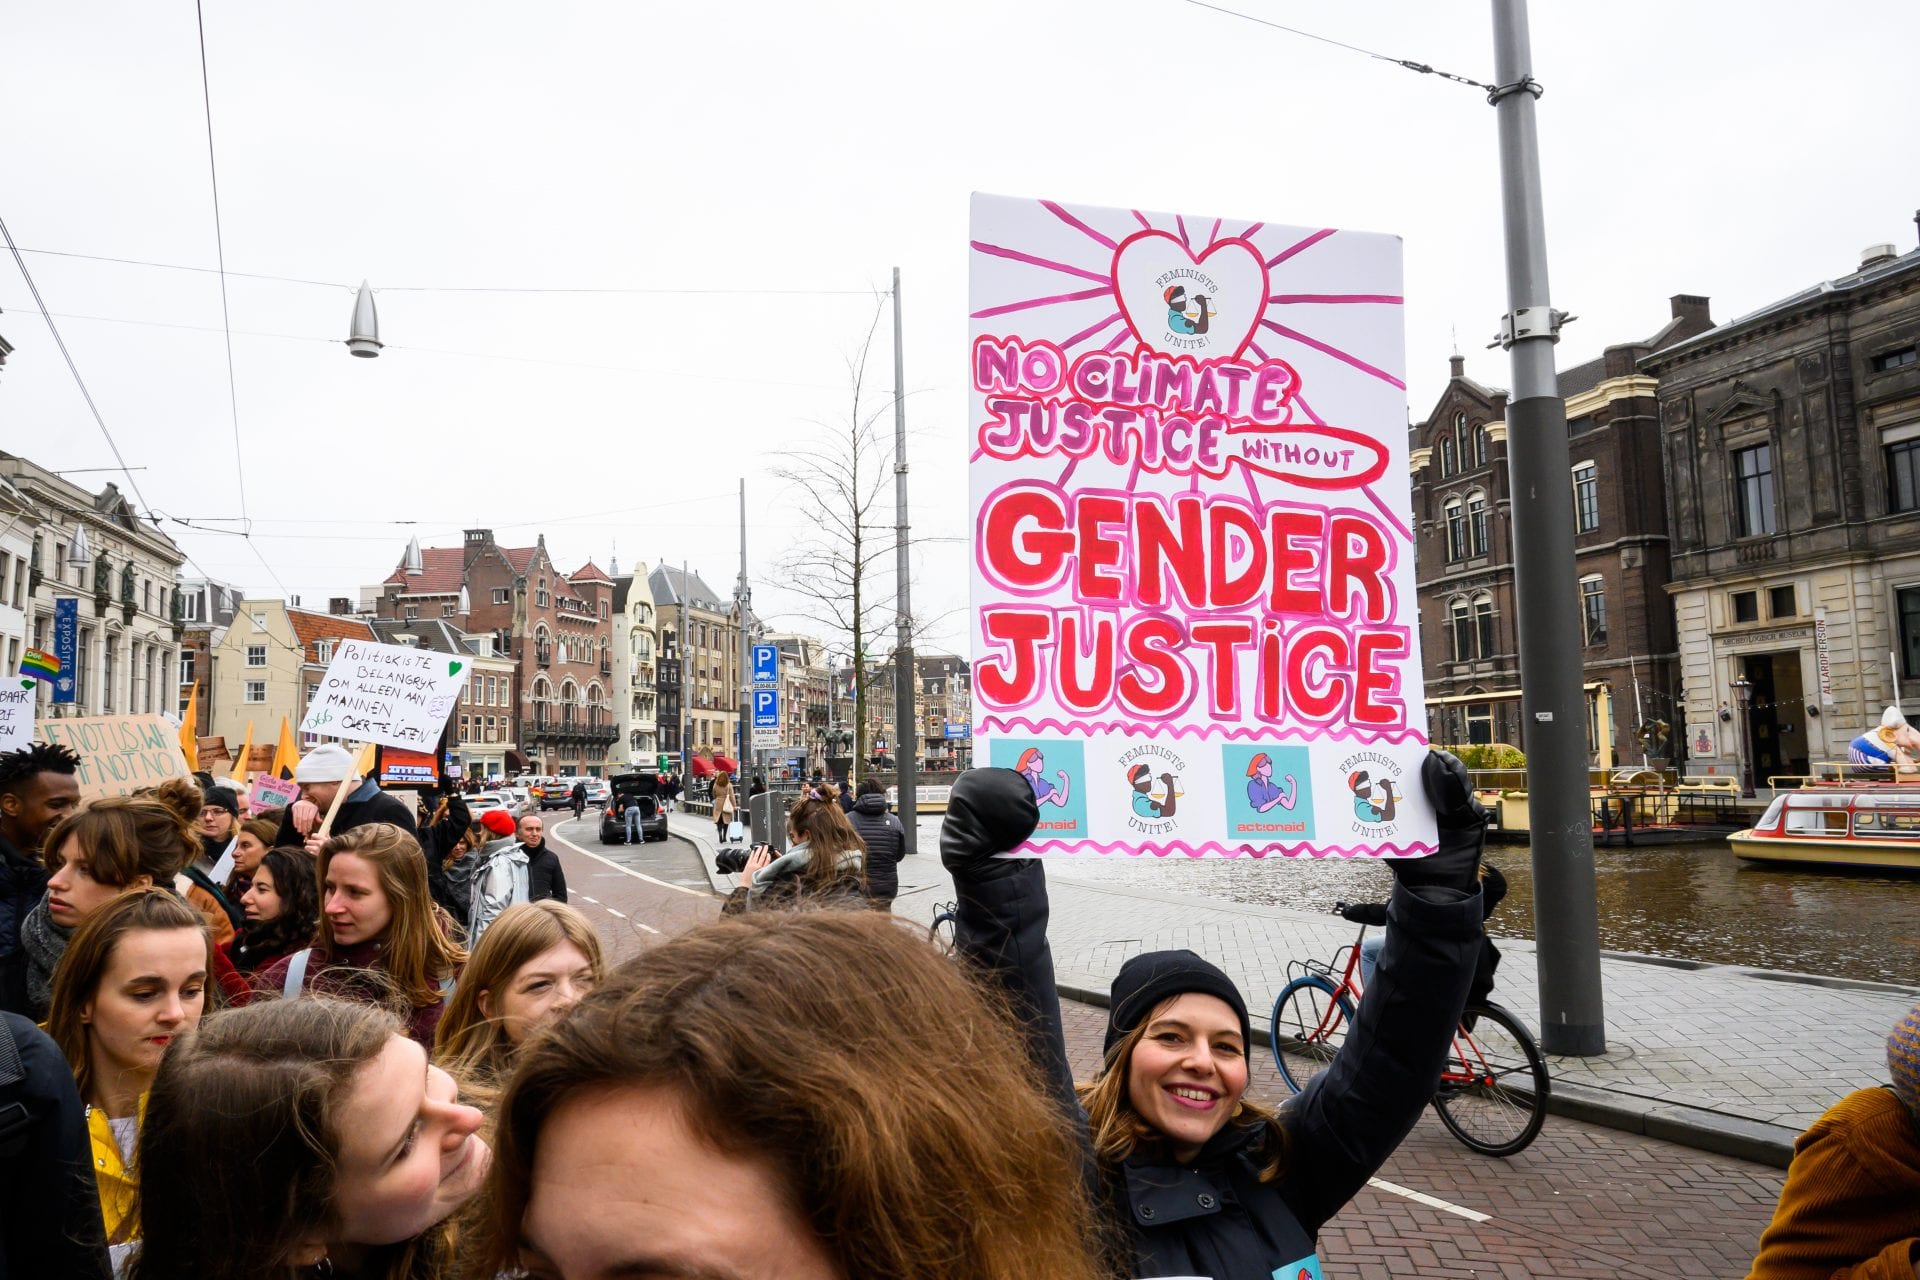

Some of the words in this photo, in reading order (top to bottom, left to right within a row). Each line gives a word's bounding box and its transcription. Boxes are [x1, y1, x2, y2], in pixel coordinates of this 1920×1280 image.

[1155, 268, 1218, 294] FEMINISTS
[1164, 332, 1211, 349] UNITE!
[976, 341, 1061, 391] NO
[983, 490, 1389, 622] GENDER
[61, 617, 72, 671] EXPOSITIE
[1779, 630, 1807, 639] MUSEUM
[416, 656, 433, 670] TE
[758, 648, 772, 668] P
[328, 678, 350, 688] OM
[355, 682, 401, 699] ALLEEN
[404, 691, 427, 707] AAN
[758, 693, 773, 712] P
[326, 694, 394, 718] MANNEN
[306, 709, 333, 730] D66
[65, 723, 107, 753] NOT
[95, 752, 137, 784] NOT
[1118, 745, 1186, 771] FEMINISTS
[1339, 752, 1402, 777] FEMINISTS
[261, 790, 289, 808] FUN
[1036, 819, 1077, 830] onaid
[1128, 817, 1179, 835] UNITE!
[1351, 821, 1399, 839] UNITE!
